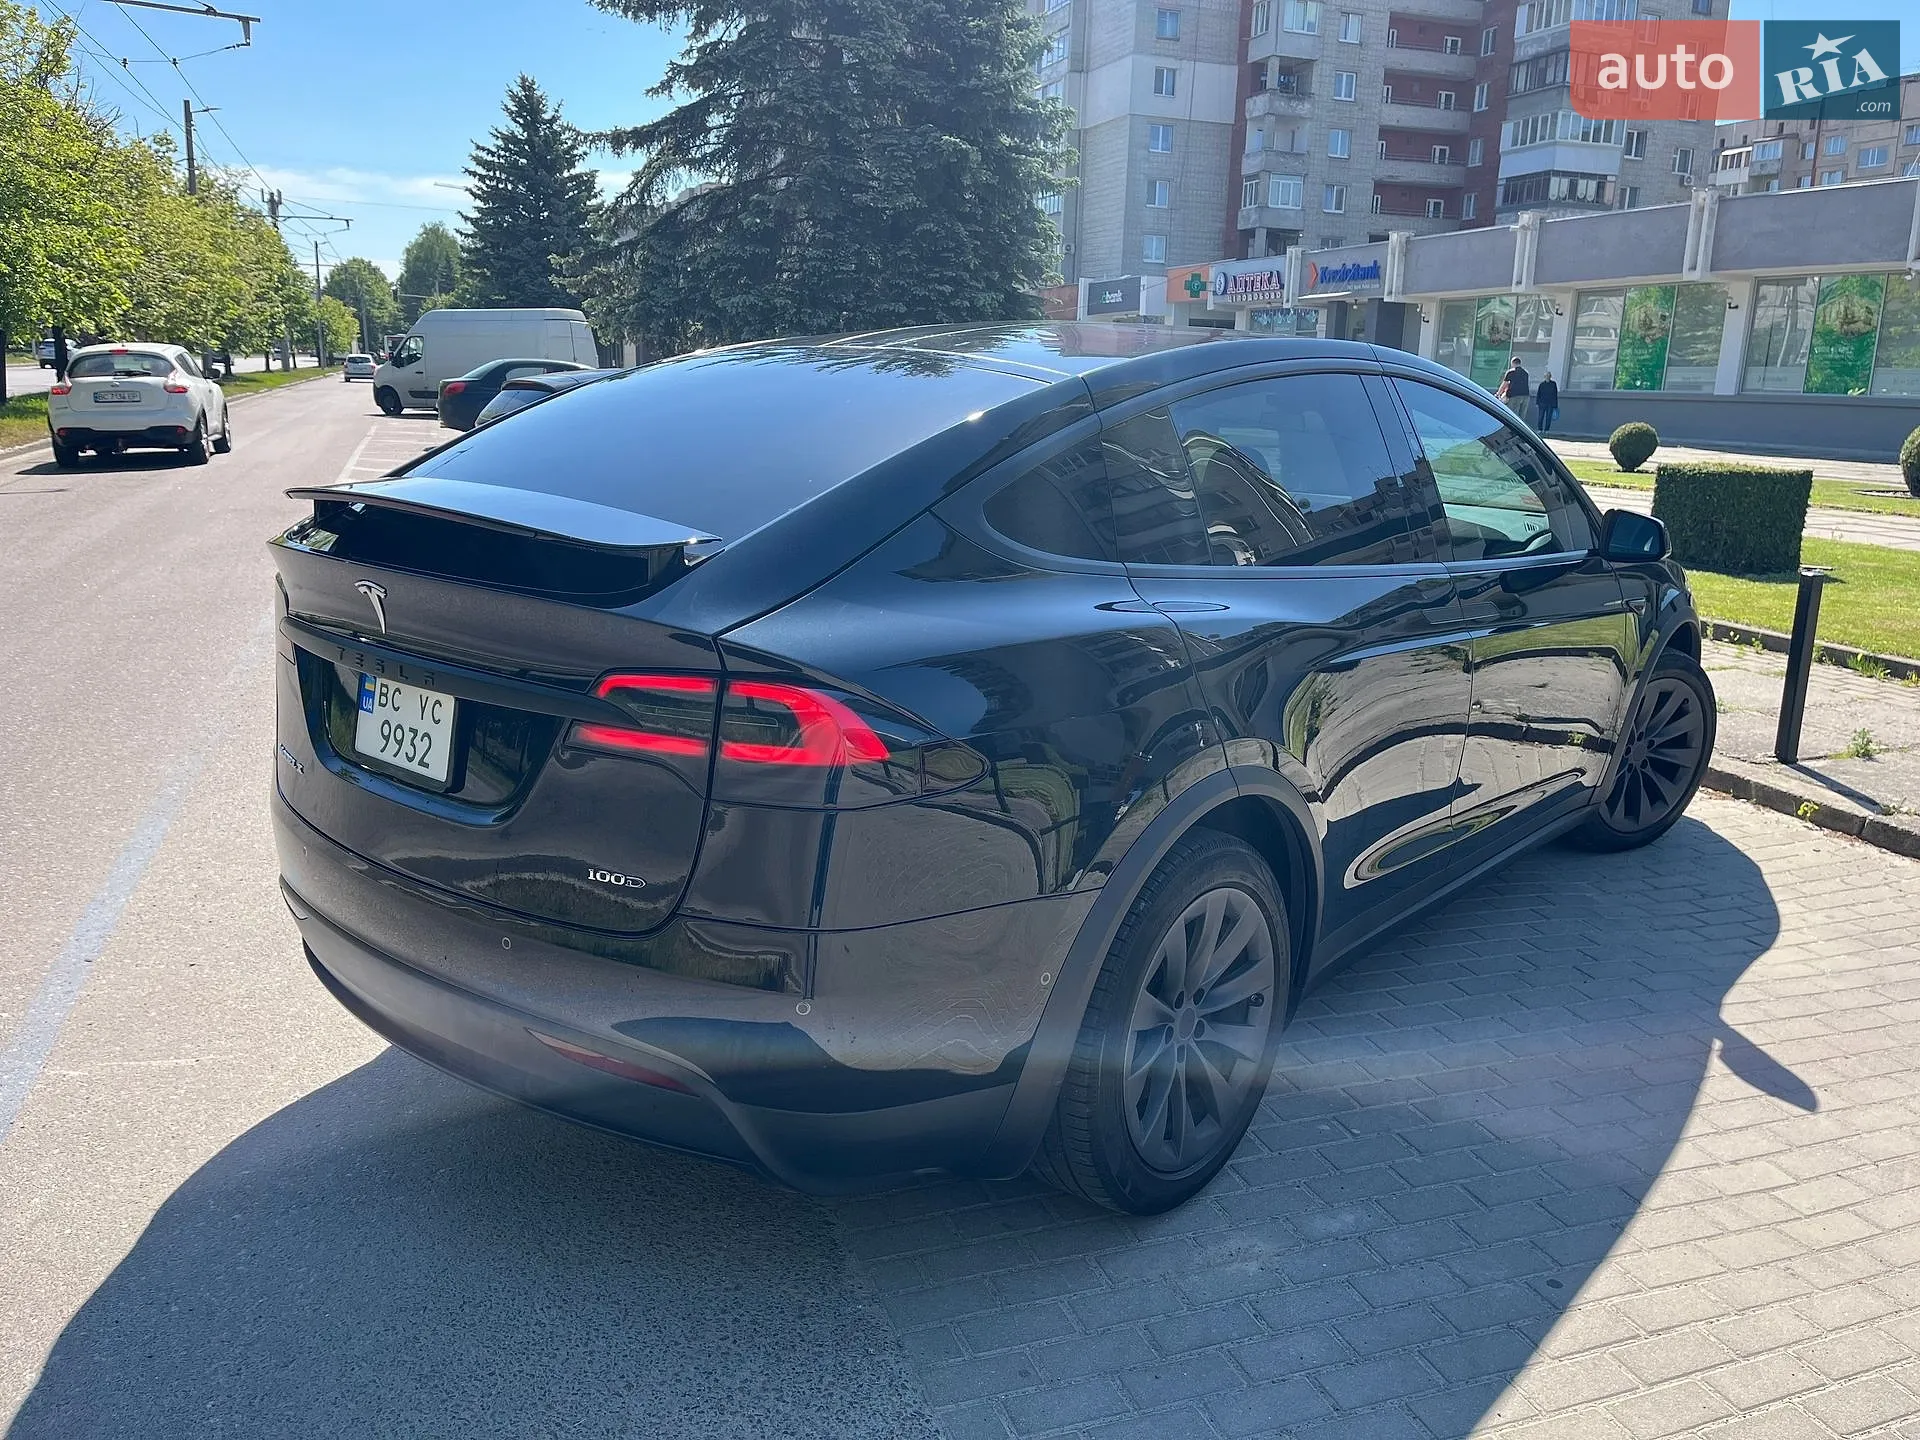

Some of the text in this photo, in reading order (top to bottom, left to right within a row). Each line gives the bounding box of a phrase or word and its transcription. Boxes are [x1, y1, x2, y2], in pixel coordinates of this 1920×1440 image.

[1227, 270, 1281, 294] АПТЕКА
[337, 646, 434, 686] TESLA
[362, 696, 374, 713] UA
[378, 682, 442, 725] BC YC
[380, 719, 432, 769] 9932
[587, 868, 647, 888] 100D
